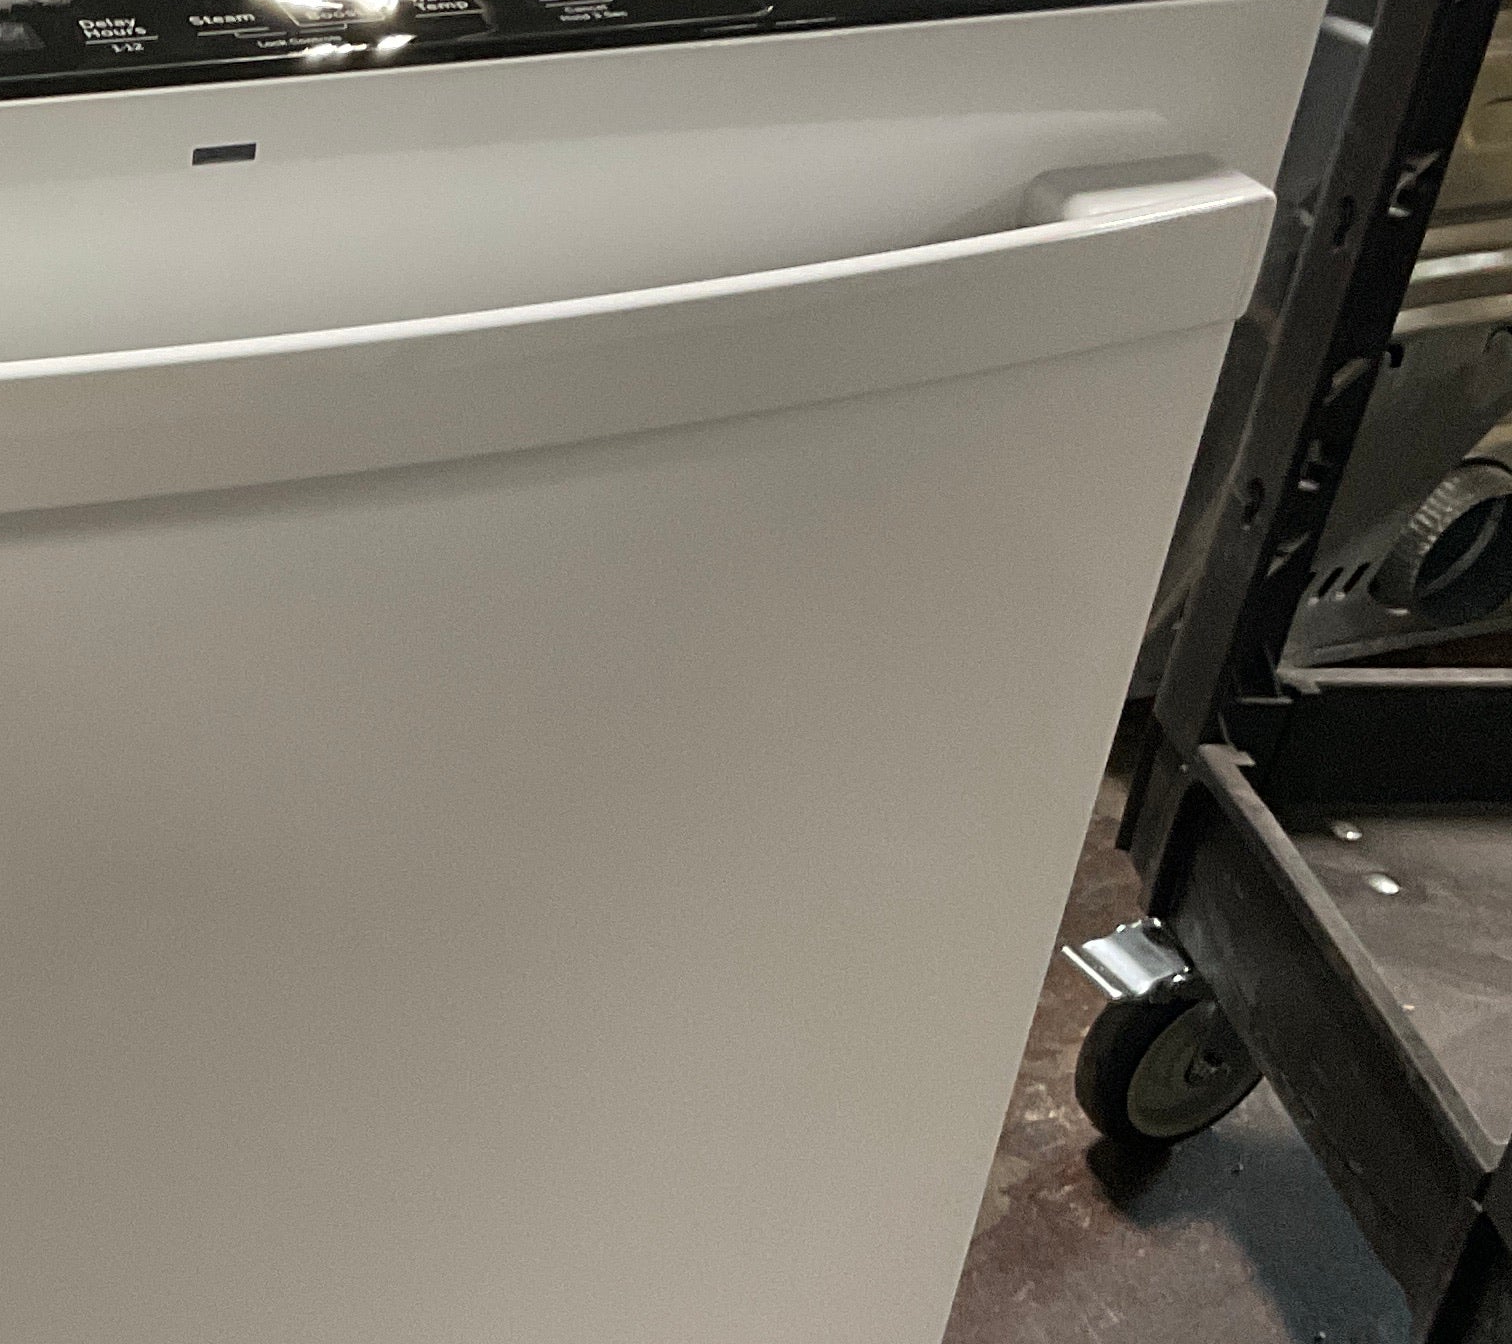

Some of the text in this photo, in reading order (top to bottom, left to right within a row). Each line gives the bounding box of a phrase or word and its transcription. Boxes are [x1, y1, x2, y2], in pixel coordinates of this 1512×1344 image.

[78, 17, 135, 30] Delay
[189, 13, 256, 26] Steam
[83, 26, 147, 39] Hours
